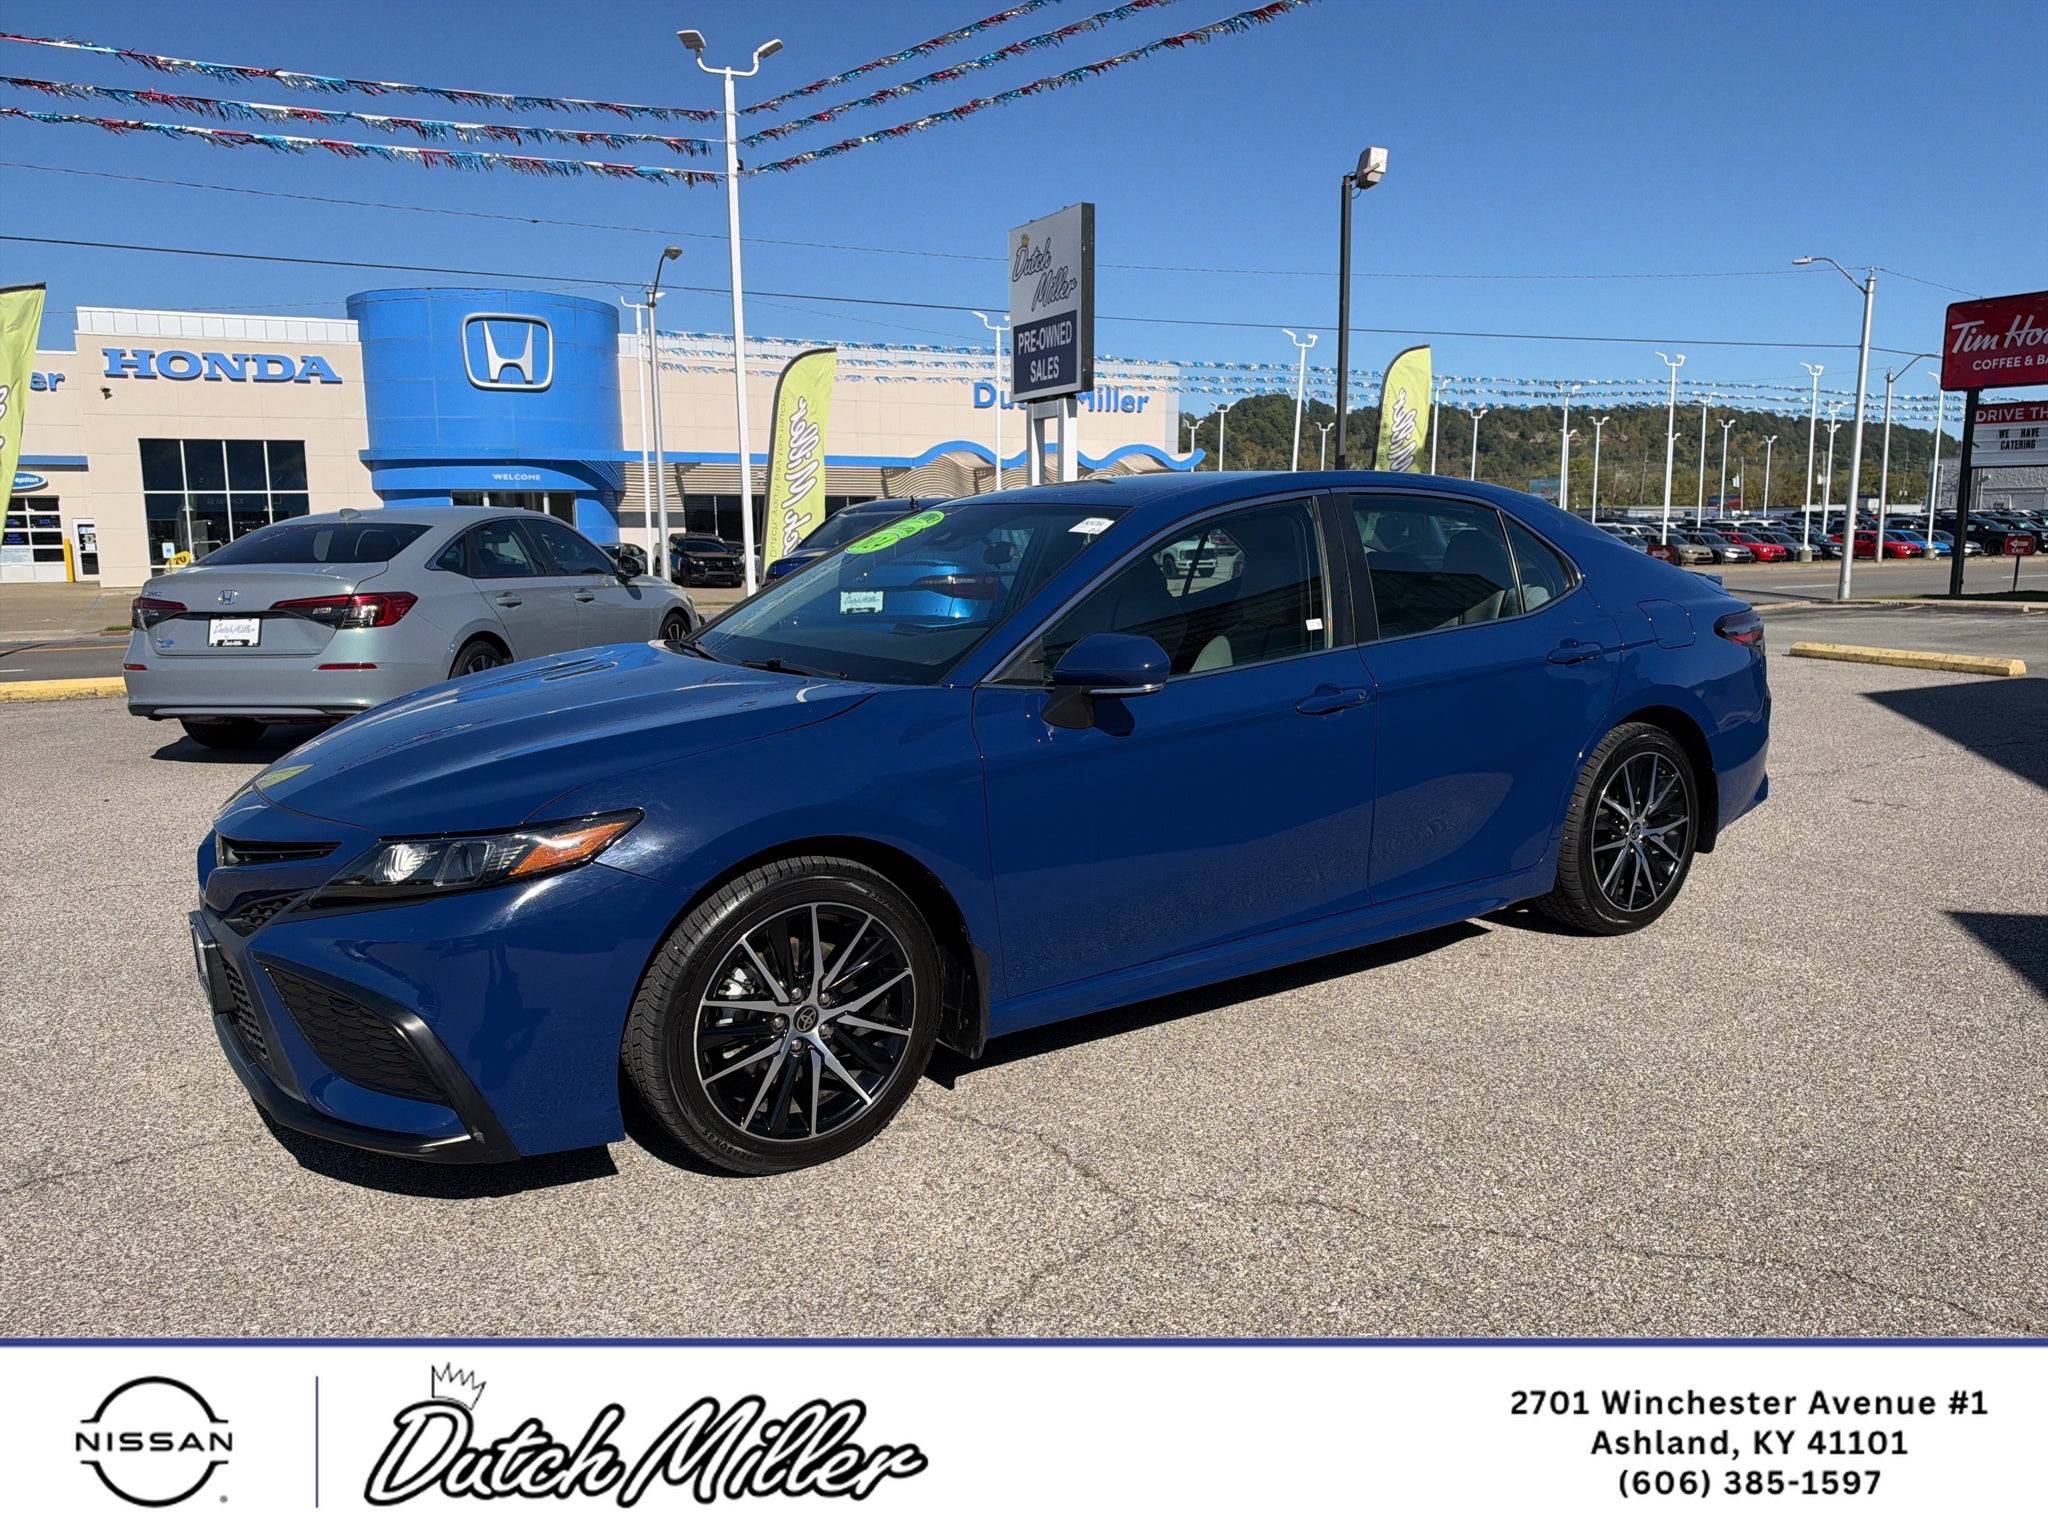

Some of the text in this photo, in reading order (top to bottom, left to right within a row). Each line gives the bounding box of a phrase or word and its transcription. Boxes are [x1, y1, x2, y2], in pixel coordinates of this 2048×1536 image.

[1012, 237, 1051, 282] Dutch
[1031, 266, 1077, 312] Miller
[1018, 320, 1072, 356] PRE-OWNED
[1951, 320, 1999, 354] Tim
[101, 347, 343, 385] HONDA
[1030, 355, 1060, 384] SALES
[1972, 356, 2021, 371] COFFEE
[2024, 355, 2034, 366] &
[1975, 408, 2025, 422] DRIVE
[1999, 427, 2040, 439] WE HAVE
[2000, 439, 2036, 450] CATERING
[492, 473, 541, 481] WELCOME
